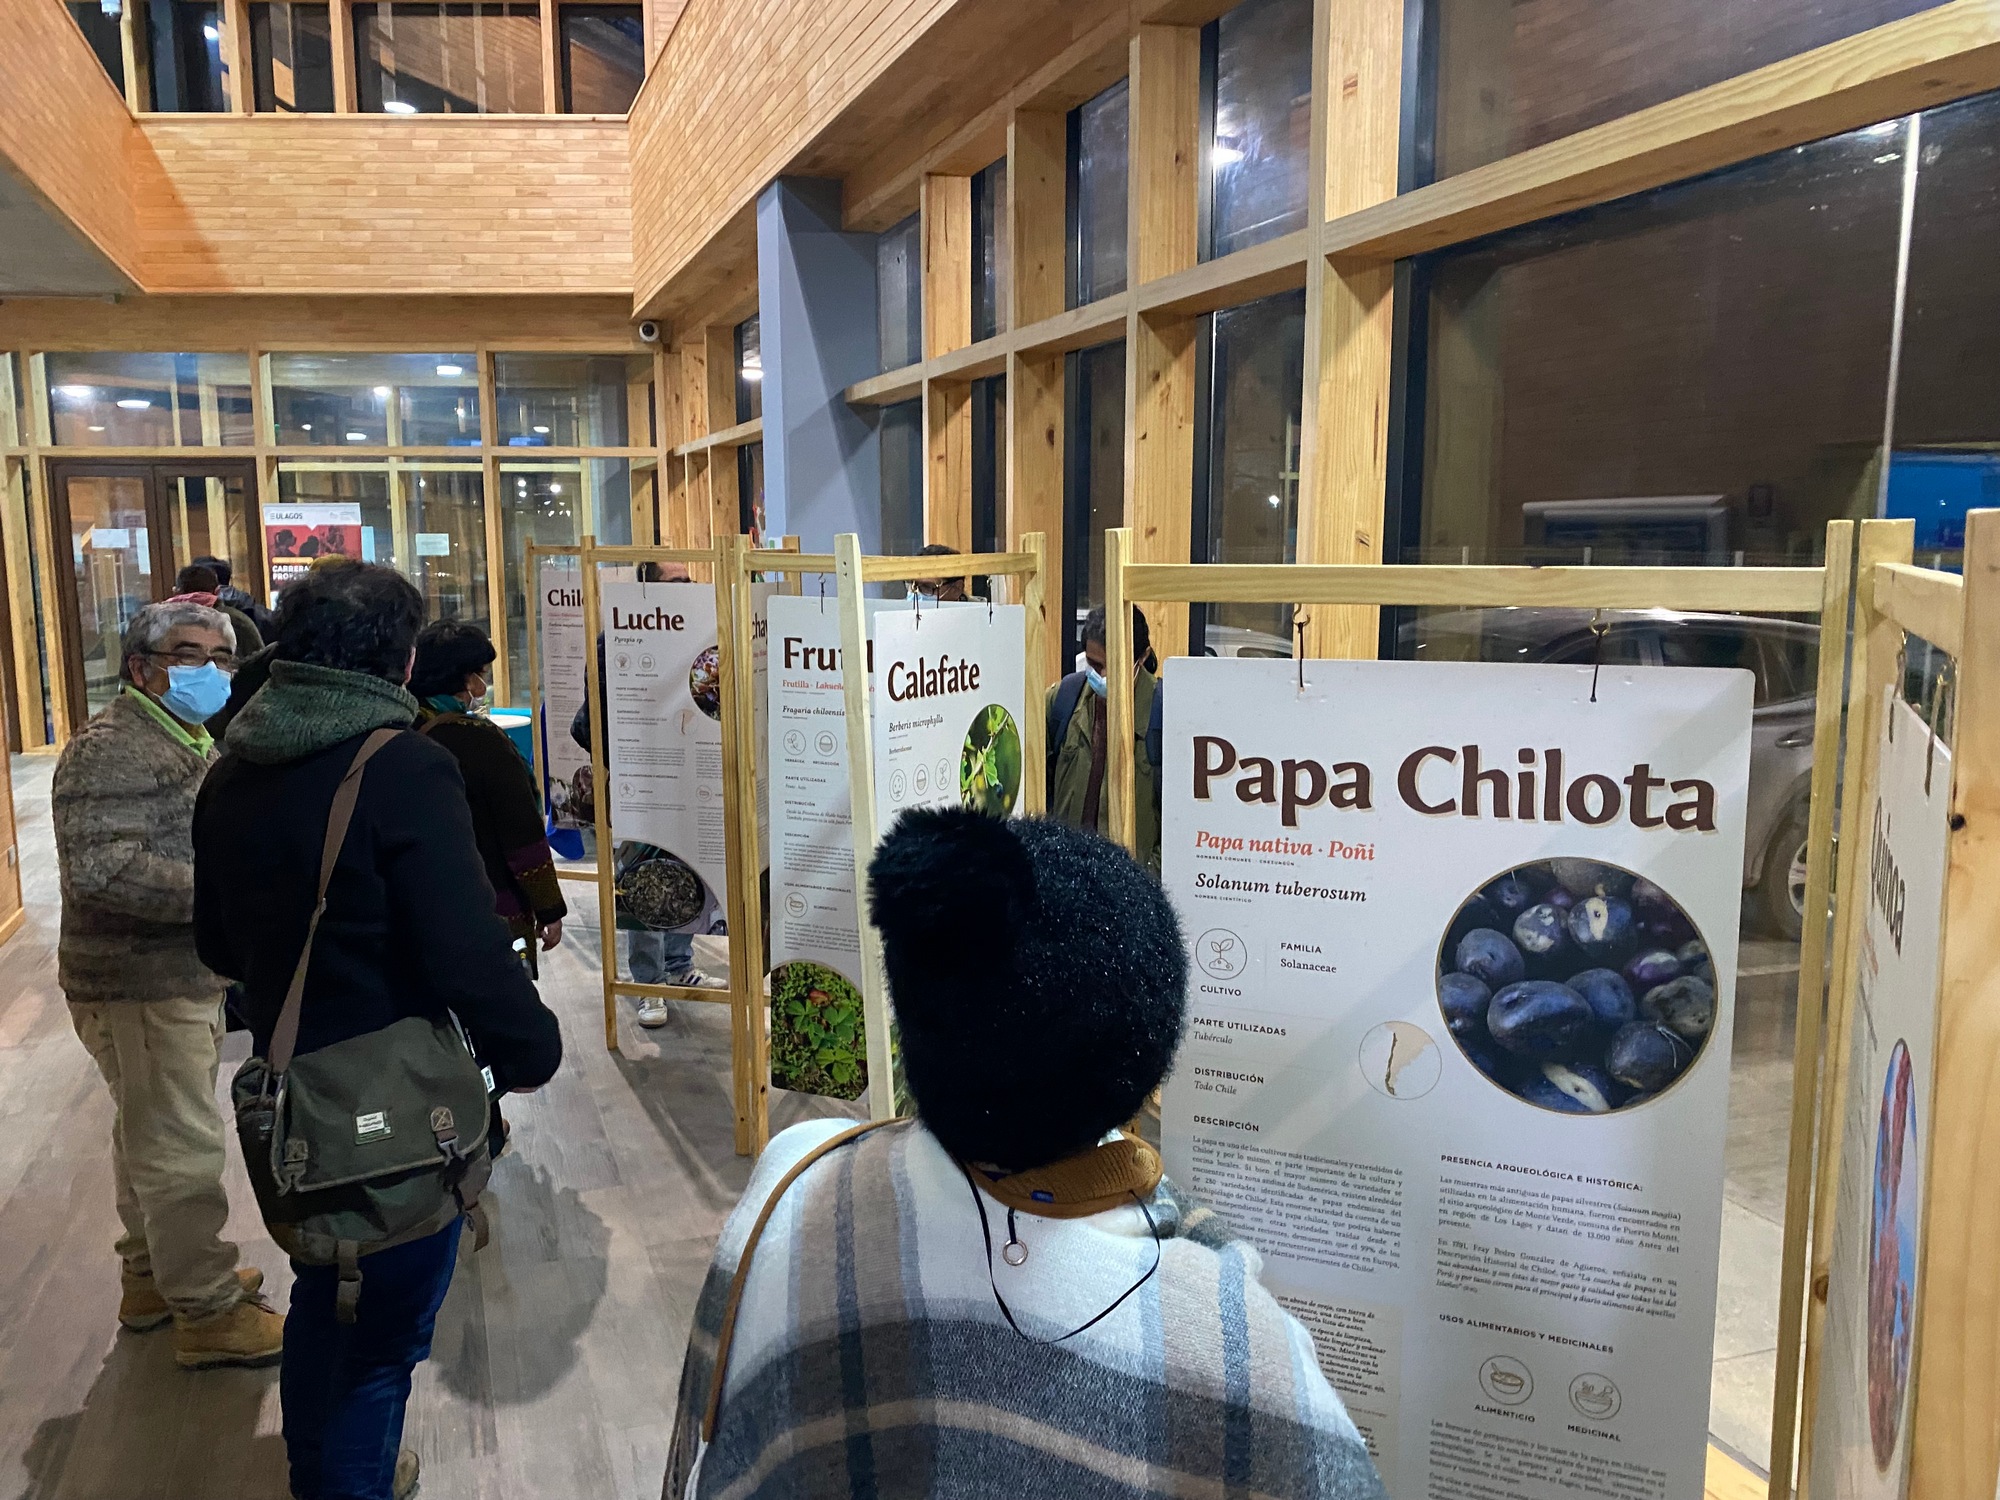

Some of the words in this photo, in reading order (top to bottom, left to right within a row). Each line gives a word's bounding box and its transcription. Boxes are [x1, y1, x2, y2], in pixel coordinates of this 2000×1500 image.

[275, 512, 303, 520] ULAGOS
[612, 606, 685, 631] Luche
[782, 680, 810, 689] Frutilla
[887, 654, 980, 701] Calafate
[782, 705, 812, 715] Fragaria
[813, 707, 845, 717] chiloensis
[889, 720, 912, 733] Berberis
[912, 714, 944, 728] microphylla
[1192, 735, 1374, 828] Papa
[1397, 744, 1719, 833] Chilota
[1195, 830, 1244, 855] Papa
[1248, 837, 1313, 856] nativa
[1328, 840, 1376, 861] Poñi
[1871, 795, 1905, 957] Quinoa
[1195, 873, 1270, 894] Solanum
[1275, 881, 1367, 902] tuberosum
[1280, 942, 1322, 954] FAMILIA
[1280, 958, 1337, 973] Solanaceae
[1200, 985, 1242, 997] CULTIVO
[1193, 1017, 1224, 1028] PARTE
[1227, 1021, 1287, 1036] UTILIZADAS
[1193, 1031, 1233, 1045] Tubérculo
[1194, 1067, 1264, 1084] DISTRIBUCIÓN
[1194, 1080, 1213, 1091] Todo
[1215, 1083, 1237, 1095] Chile
[1193, 1115, 1260, 1132] DESCRIPCIÓN
[1201, 1138, 1217, 1146] papa
[1260, 1148, 1287, 1157] cultivos
[1303, 1154, 1348, 1167] tradicionales
[1222, 1151, 1235, 1159] por
[1305, 1165, 1345, 1176] importante
[1368, 1175, 1395, 1185] cultura
[1440, 1154, 1493, 1169] PRESENCIA
[1496, 1162, 1573, 1182] ARQUEOLÓGICA
[1576, 1175, 1583, 1183] E
[1586, 1176, 1643, 1192] HISTÓRICA:
[1254, 1165, 1270, 1174] bien
[1283, 1171, 1306, 1180] mayor
[1352, 1183, 1391, 1194] variedades
[1192, 1184, 1234, 1199] Archipiélago
[1270, 1197, 1284, 1207] Esta
[1220, 1181, 1256, 1192] variedades
[1322, 1198, 1343, 1207] papas
[1390, 1209, 1402, 1217] del
[1244, 1175, 1261, 1183] zona
[1368, 1195, 1402, 1206] alrededor
[1453, 1179, 1488, 1190] muestras
[1551, 1194, 1574, 1203] papas
[1498, 1195, 1549, 1210] alimentación
[1269, 1219, 1287, 1227] otras
[1525, 1210, 1550, 1220] Monte
[1494, 1215, 1507, 1225] Los
[1511, 1218, 1533, 1229] Lagos
[1637, 1240, 1662, 1250] Antes
[1666, 1244, 1679, 1254] del
[1439, 1314, 1464, 1325] USOS
[1466, 1318, 1537, 1339] ALIMENTARIOS
[1538, 1333, 1545, 1341] Y
[1548, 1334, 1614, 1354] MEDICINALES
[1474, 1404, 1536, 1423] ALIMENTICIO
[1567, 1424, 1621, 1442] MEDICINAL
